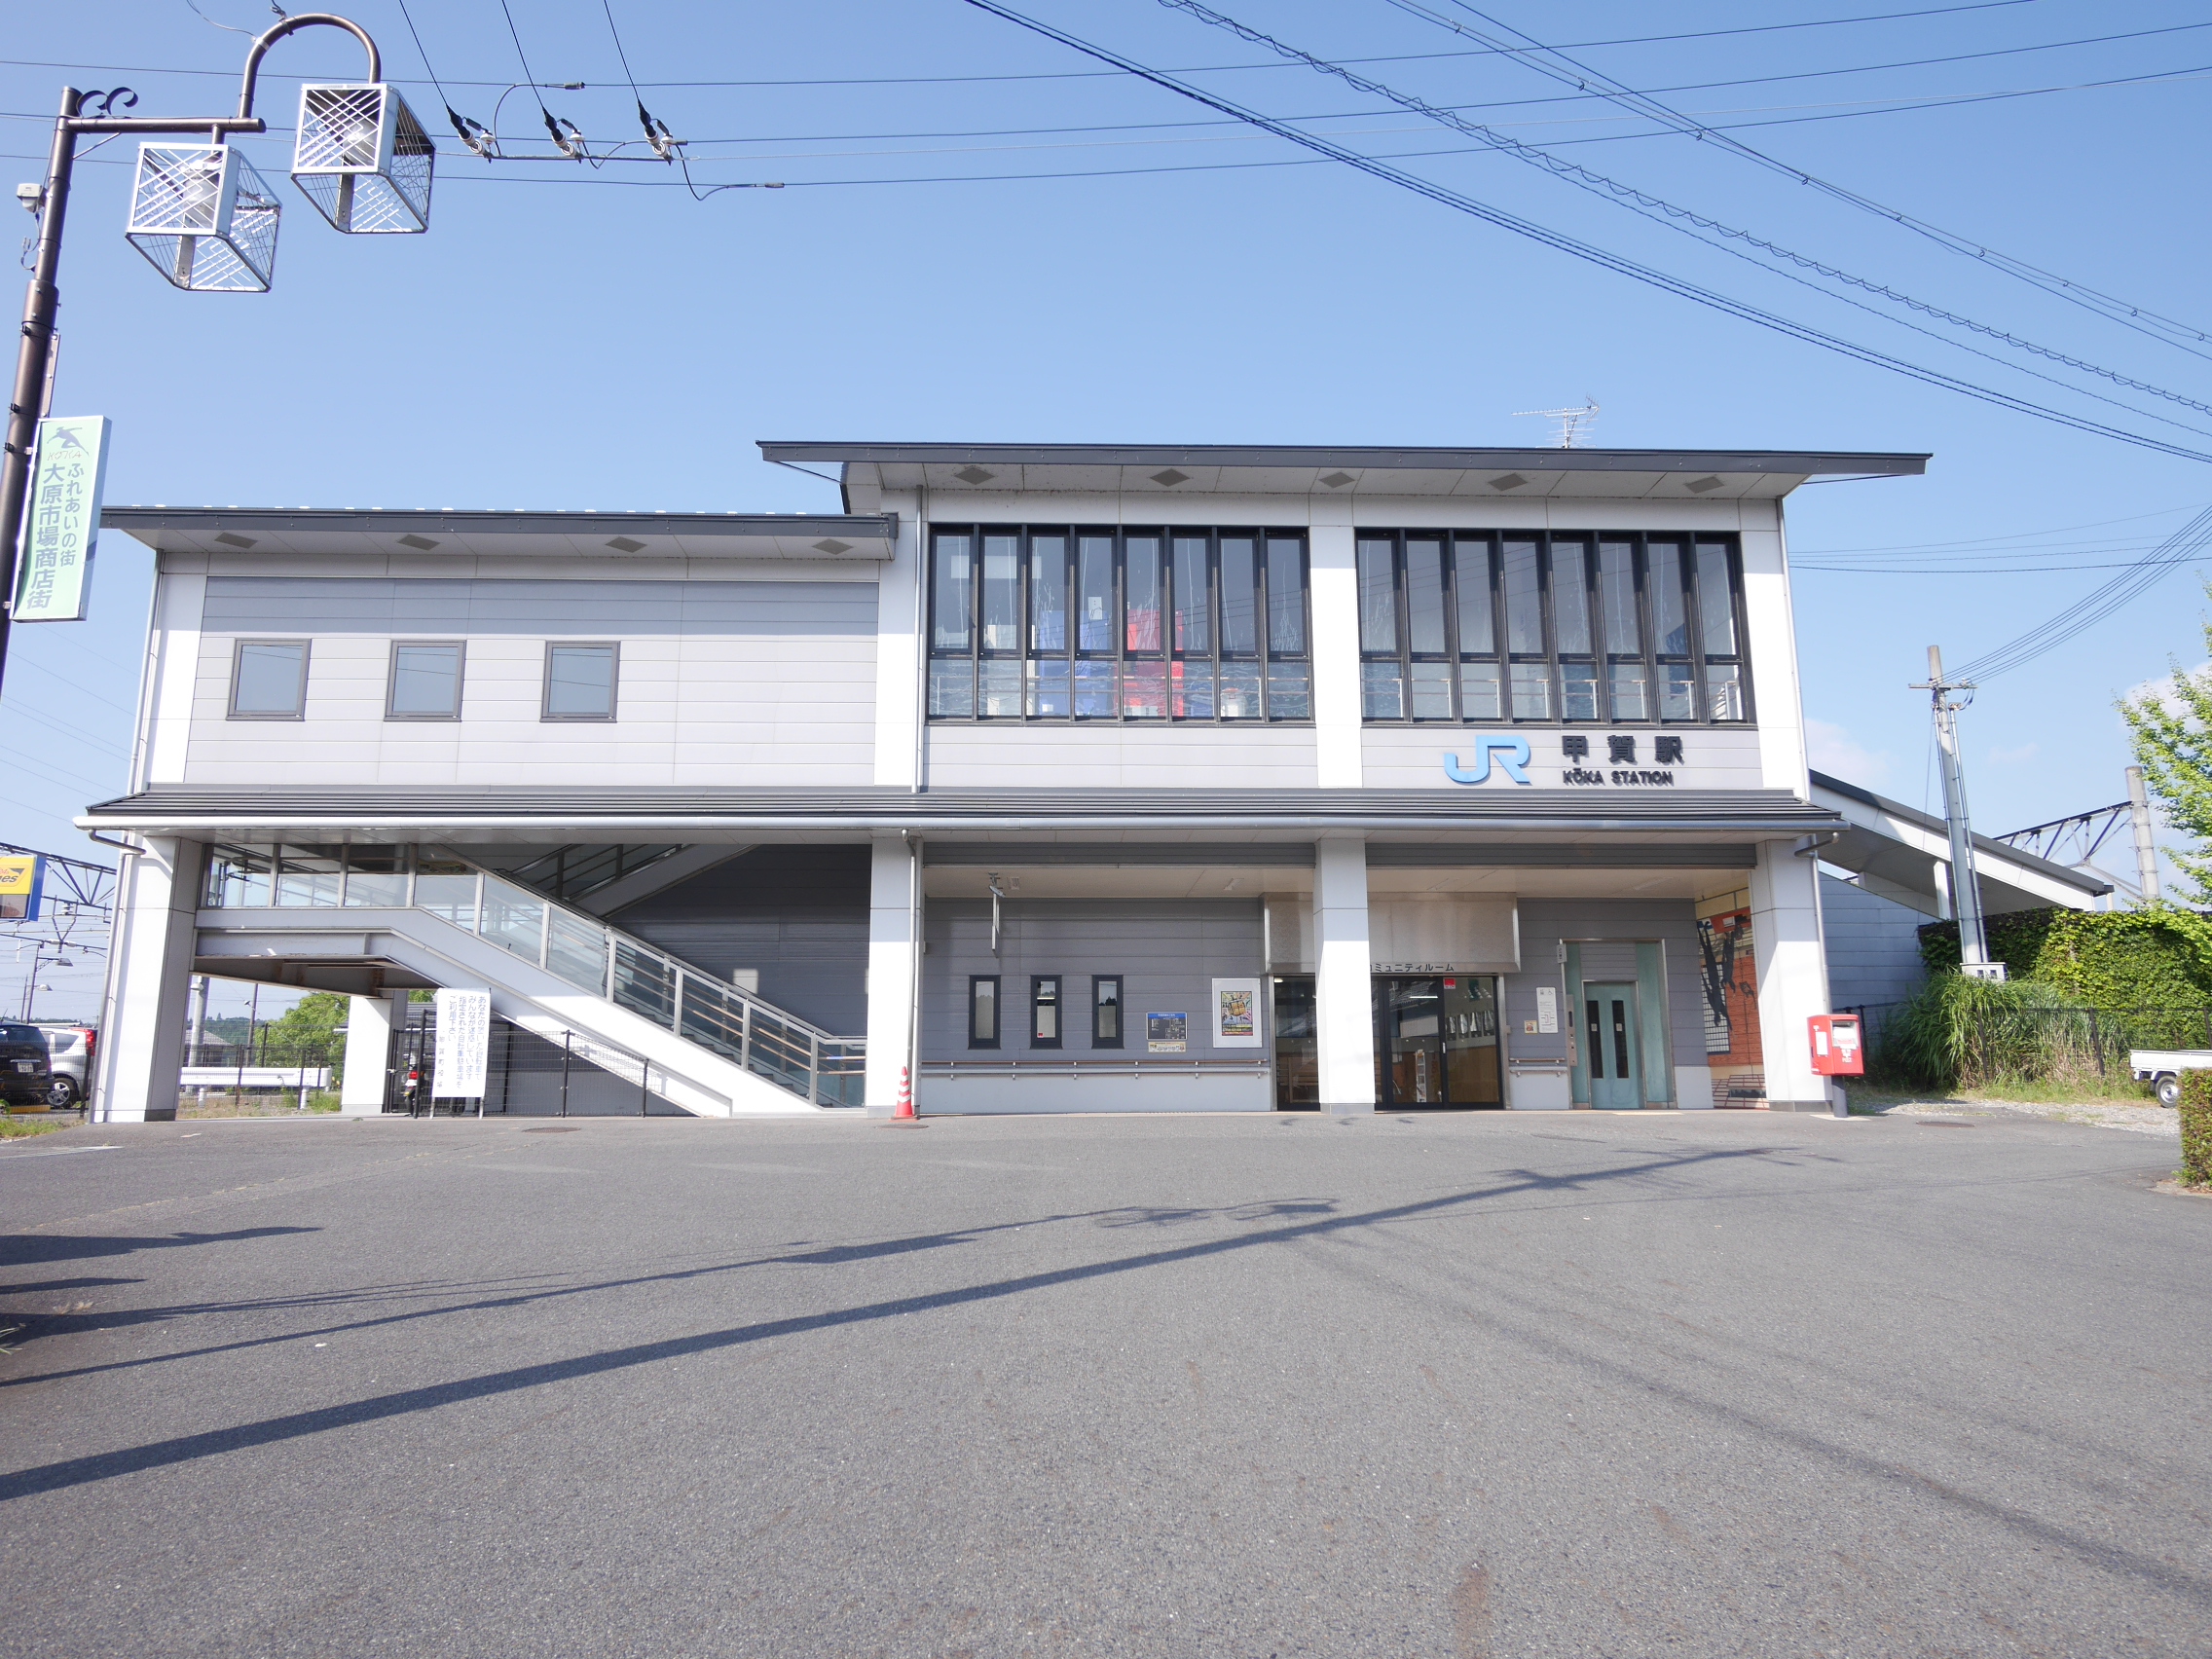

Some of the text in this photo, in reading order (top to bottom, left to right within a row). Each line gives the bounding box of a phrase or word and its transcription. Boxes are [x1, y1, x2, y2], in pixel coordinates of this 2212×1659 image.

[26, 462, 65, 610] 大原市場商店街
[59, 462, 85, 568] ふれあいの街
[1444, 734, 1530, 784] JR
[1562, 735, 1683, 763] 甲賀駅
[1611, 770, 1674, 785] STATION
